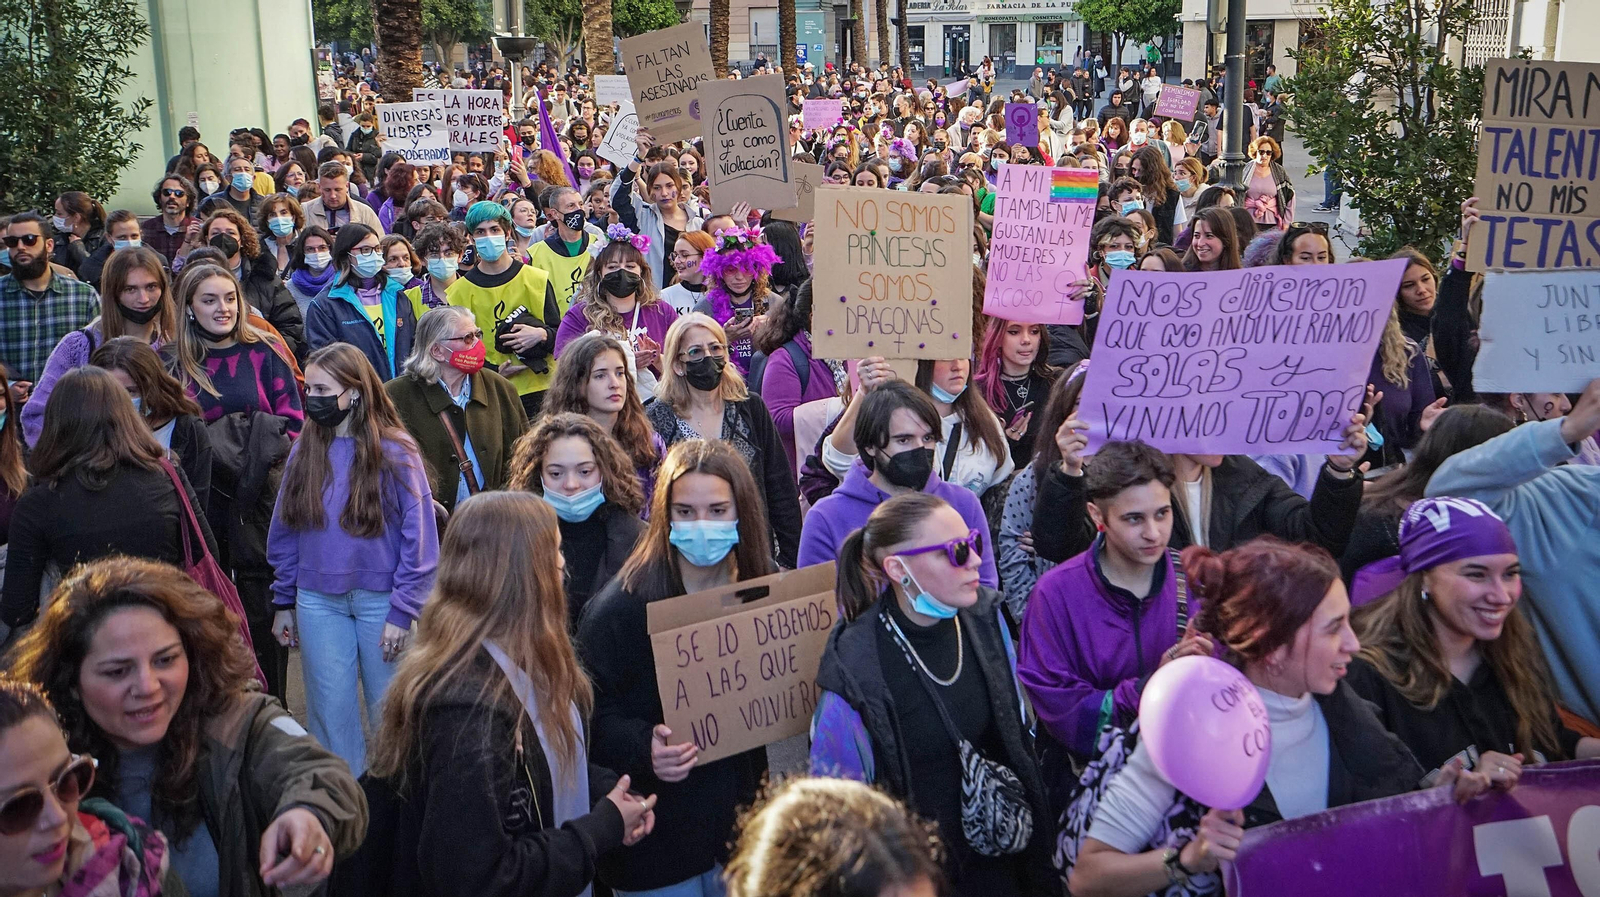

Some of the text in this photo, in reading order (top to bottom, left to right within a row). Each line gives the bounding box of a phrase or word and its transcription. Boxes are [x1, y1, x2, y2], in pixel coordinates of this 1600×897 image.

[907, 2, 931, 10] ADERIA
[636, 40, 690, 70] FALTAN
[656, 64, 683, 83] LAS
[443, 94, 460, 109] LA
[467, 95, 500, 111] HORA
[1164, 86, 1195, 97] FEMINISMO
[1491, 60, 1574, 119] MIRA
[383, 108, 443, 123] DIVERSAS
[446, 113, 503, 129] AS MUJERES
[717, 108, 768, 135] ¿Cuenta
[387, 123, 432, 139] LIBRES
[411, 139, 419, 149] Y
[719, 134, 776, 161] ya como
[719, 149, 780, 176] violación?
[1001, 168, 1044, 194] A MI
[1496, 180, 1588, 214] NO MIS
[835, 199, 956, 233] NO SOMOS
[998, 196, 1094, 229] TAMBIEN ME
[994, 221, 1074, 246] GUSTAN LAS
[1479, 215, 1600, 269] TETAS
[848, 233, 947, 268] PRINCESAS
[993, 243, 1072, 266] MUJERES Y
[858, 271, 933, 301] SOMOS
[990, 261, 1043, 283] NO LAS
[989, 287, 1044, 308] ACOSO
[1116, 272, 1367, 320] NOS dijeron
[846, 305, 944, 335] DRAGONAS
[1105, 308, 1381, 350] QUE NO ANDUVIERAMOS
[1523, 341, 1595, 371] Y SIN
[1112, 347, 1247, 399] SOLAS
[1101, 400, 1234, 440] VINIMOS
[675, 599, 832, 668] SE LO DEBEMOS
[675, 644, 799, 711] A LAS QUE
[691, 713, 719, 751] NO
